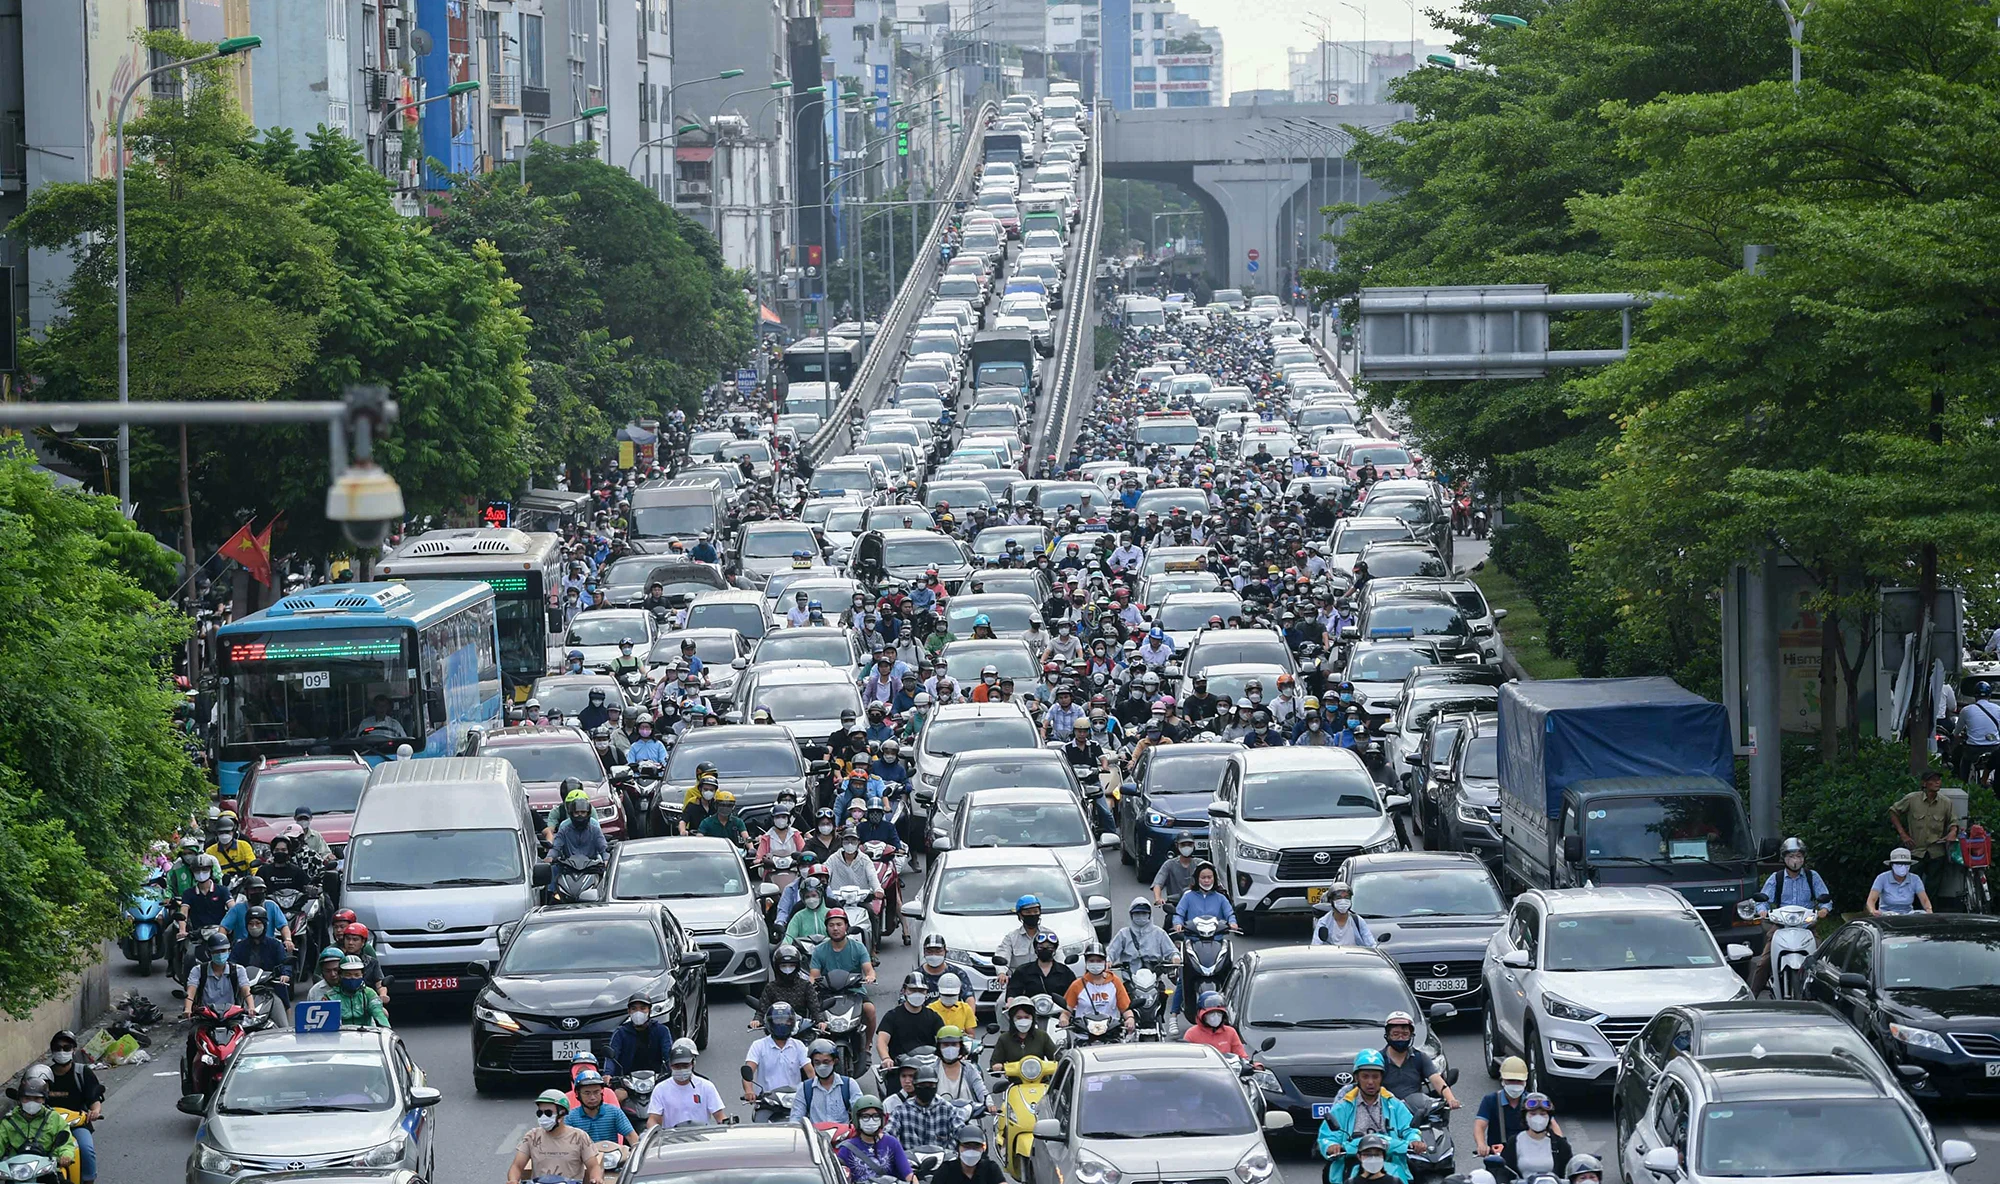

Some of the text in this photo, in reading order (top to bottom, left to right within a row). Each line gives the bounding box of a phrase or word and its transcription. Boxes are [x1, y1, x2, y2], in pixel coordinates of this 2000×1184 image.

[1784, 653, 1822, 665] Hisma
[1416, 979, 1466, 991] 30F-398.32
[306, 1005, 330, 1029] G7
[563, 1042, 580, 1050] 51K
[557, 1050, 587, 1059] 720
